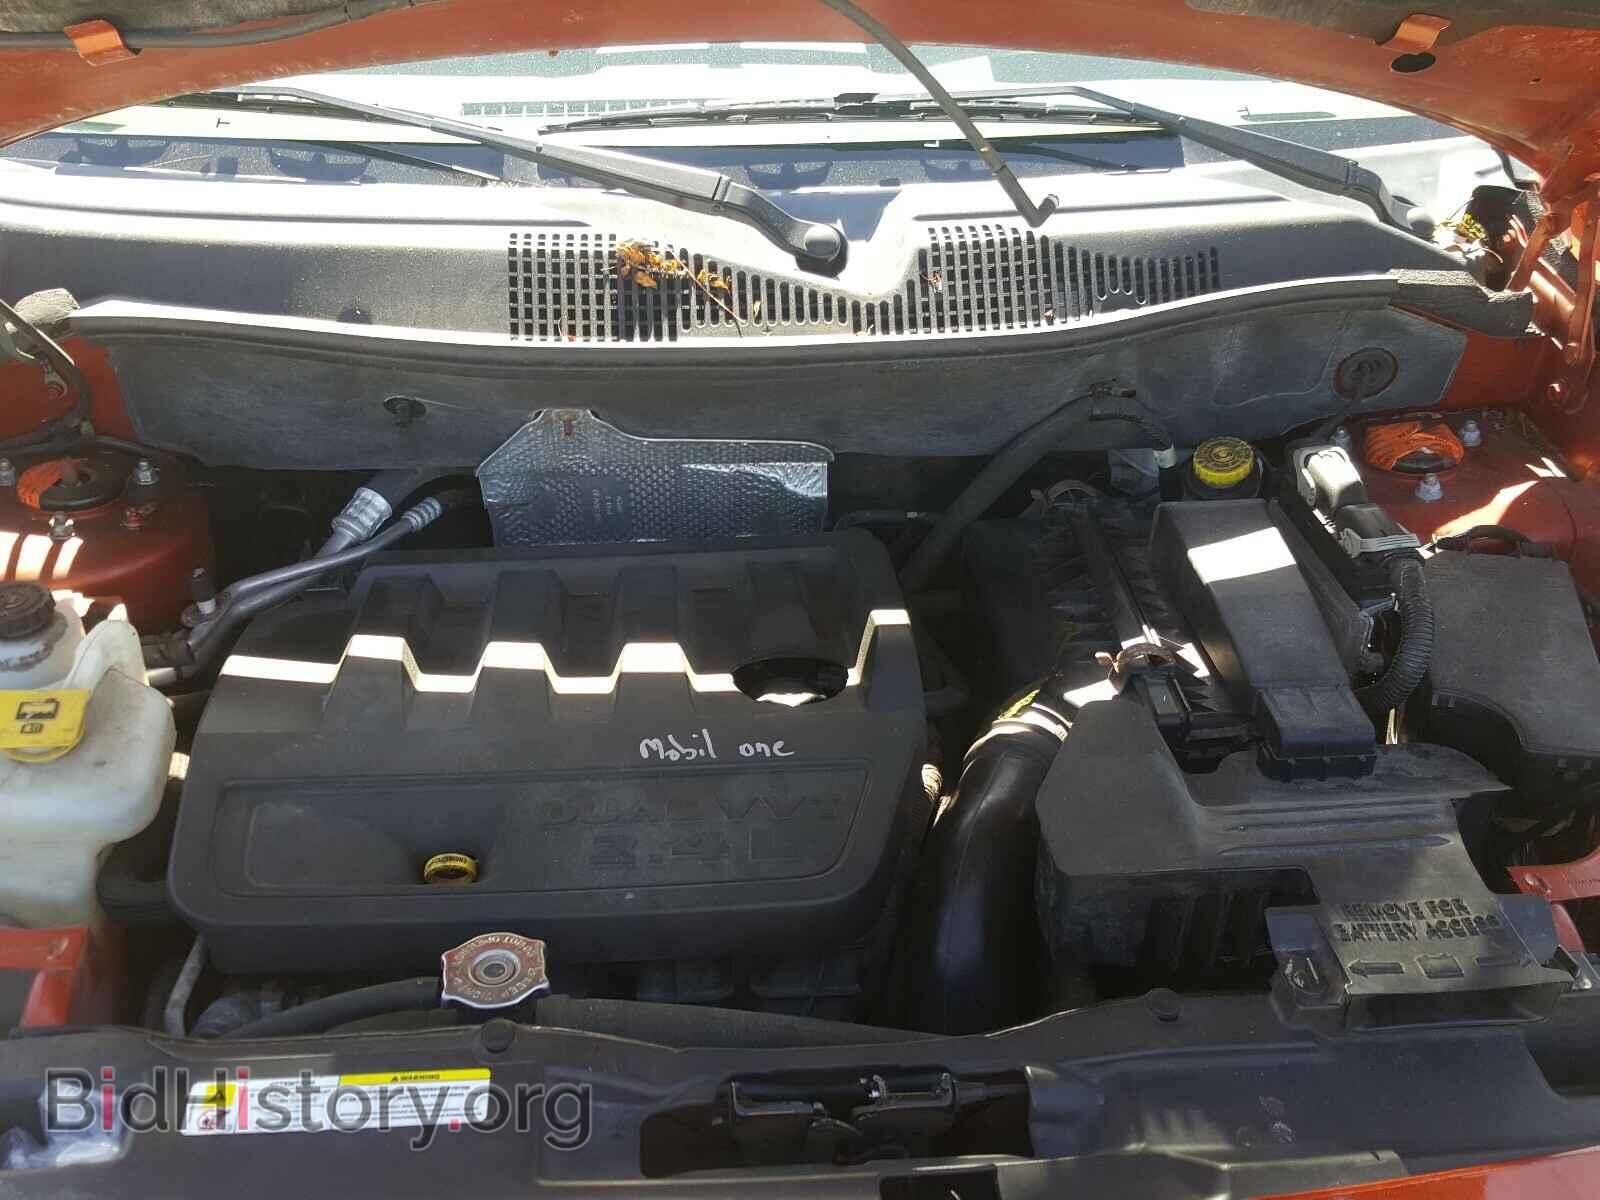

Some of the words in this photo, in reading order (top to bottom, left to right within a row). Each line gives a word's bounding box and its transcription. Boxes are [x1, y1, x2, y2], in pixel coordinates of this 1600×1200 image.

[640, 728, 717, 761] Mobil
[739, 740, 795, 758] one
[1341, 900, 1426, 922] REMOVE
[1425, 898, 1471, 918] FOR
[1333, 920, 1419, 942] BATTERY
[1426, 914, 1501, 940] ACCESS
